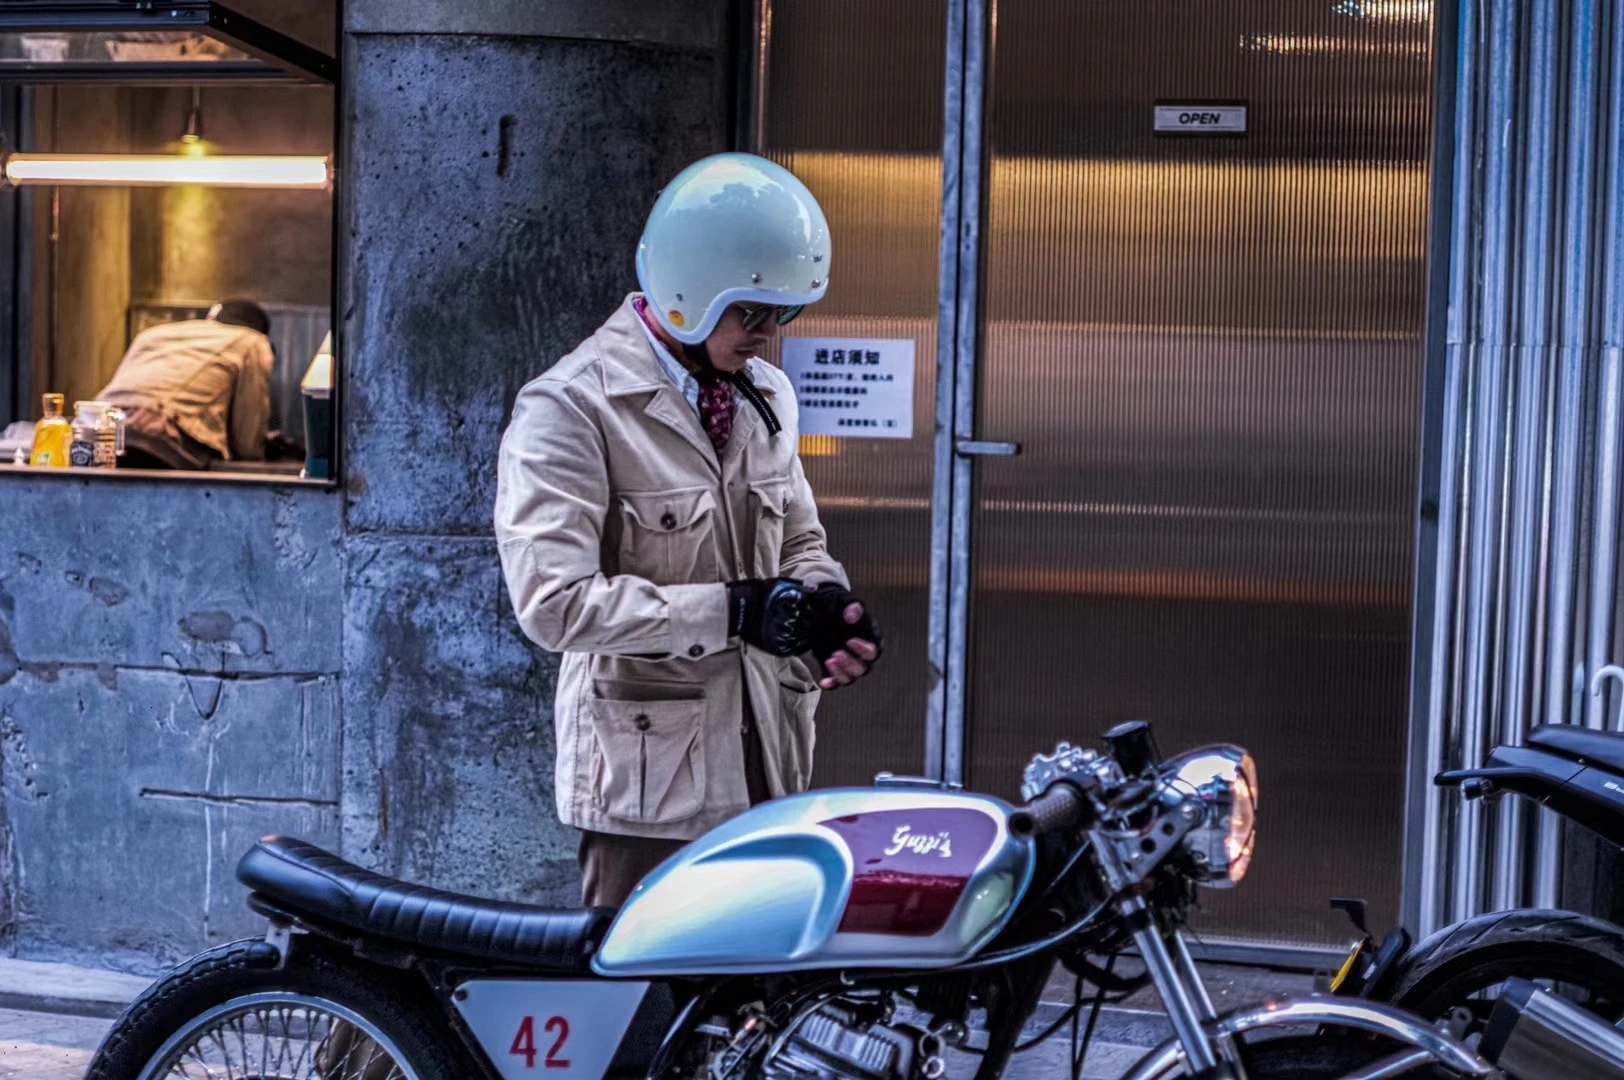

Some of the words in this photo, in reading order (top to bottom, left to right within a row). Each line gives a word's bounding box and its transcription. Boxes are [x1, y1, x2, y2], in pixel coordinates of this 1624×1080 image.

[1178, 112, 1221, 125] OPEN
[814, 348, 880, 365] 进店须知
[508, 1015, 571, 1069] 42
